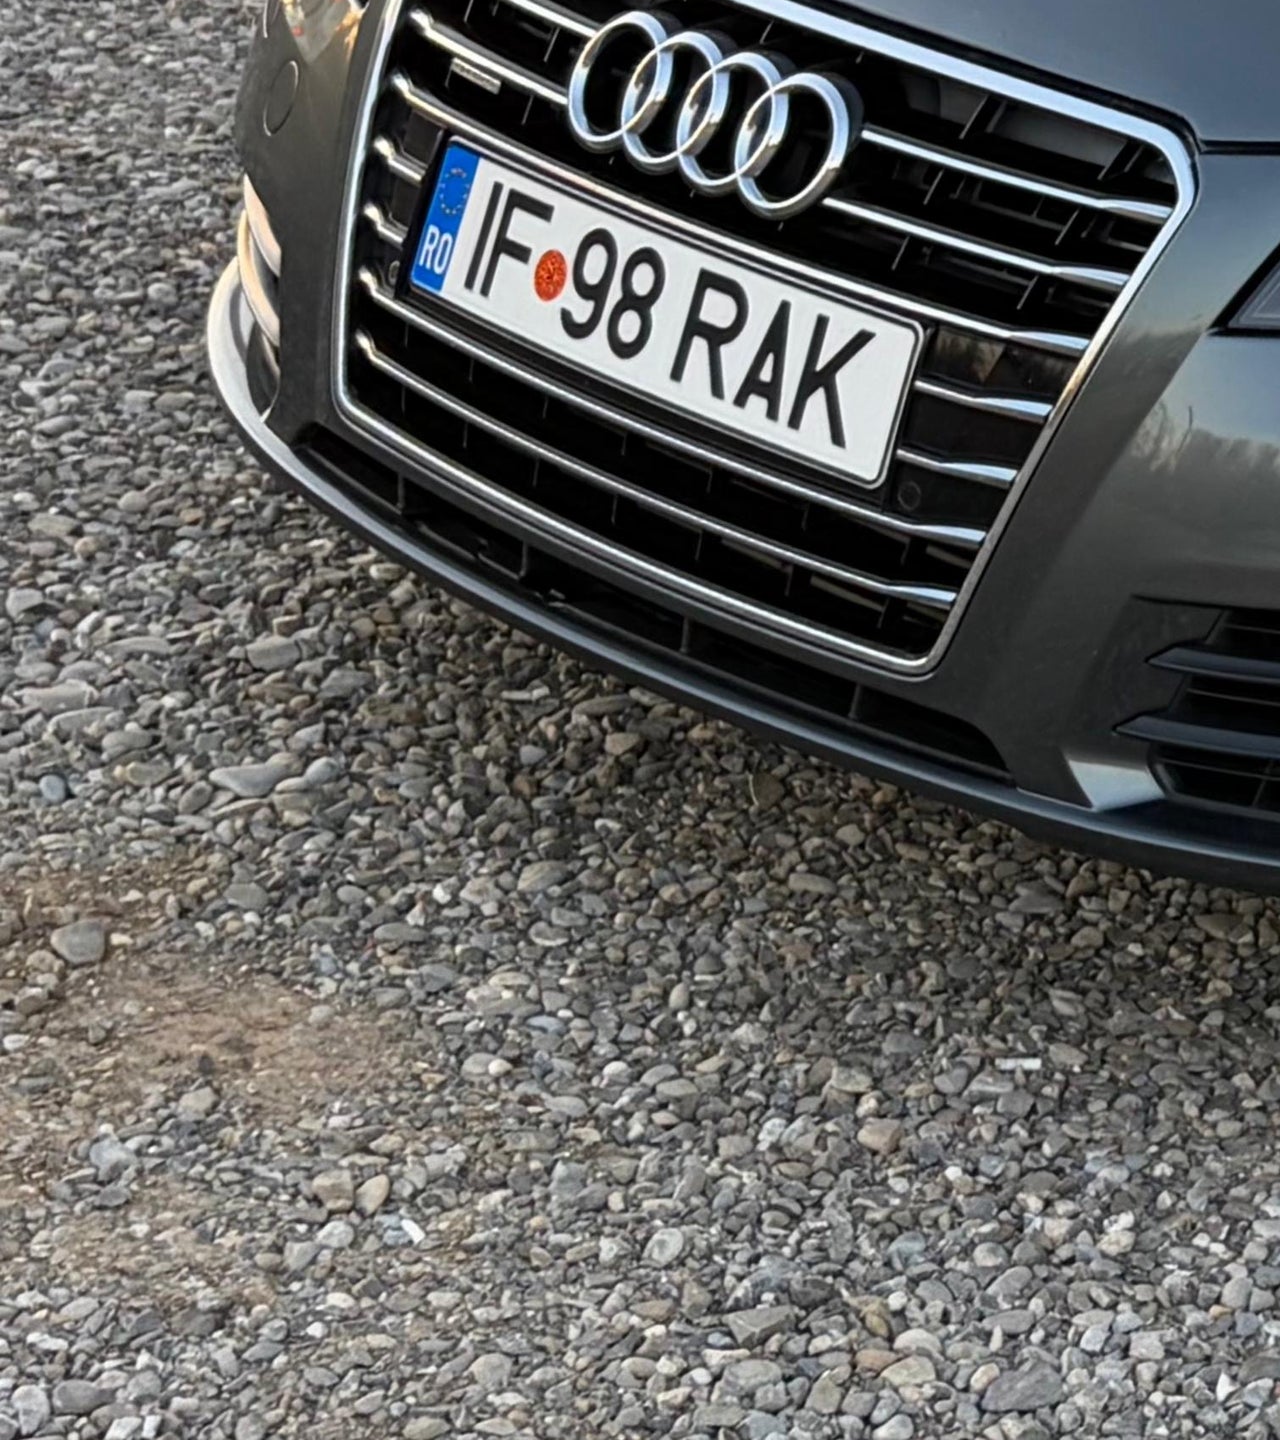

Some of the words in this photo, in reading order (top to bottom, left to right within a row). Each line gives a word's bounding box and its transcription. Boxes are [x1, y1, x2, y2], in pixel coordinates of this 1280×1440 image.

[419, 225, 454, 274] RO
[464, 180, 555, 299] IF
[559, 227, 666, 361] 98
[669, 266, 877, 450] RAK
